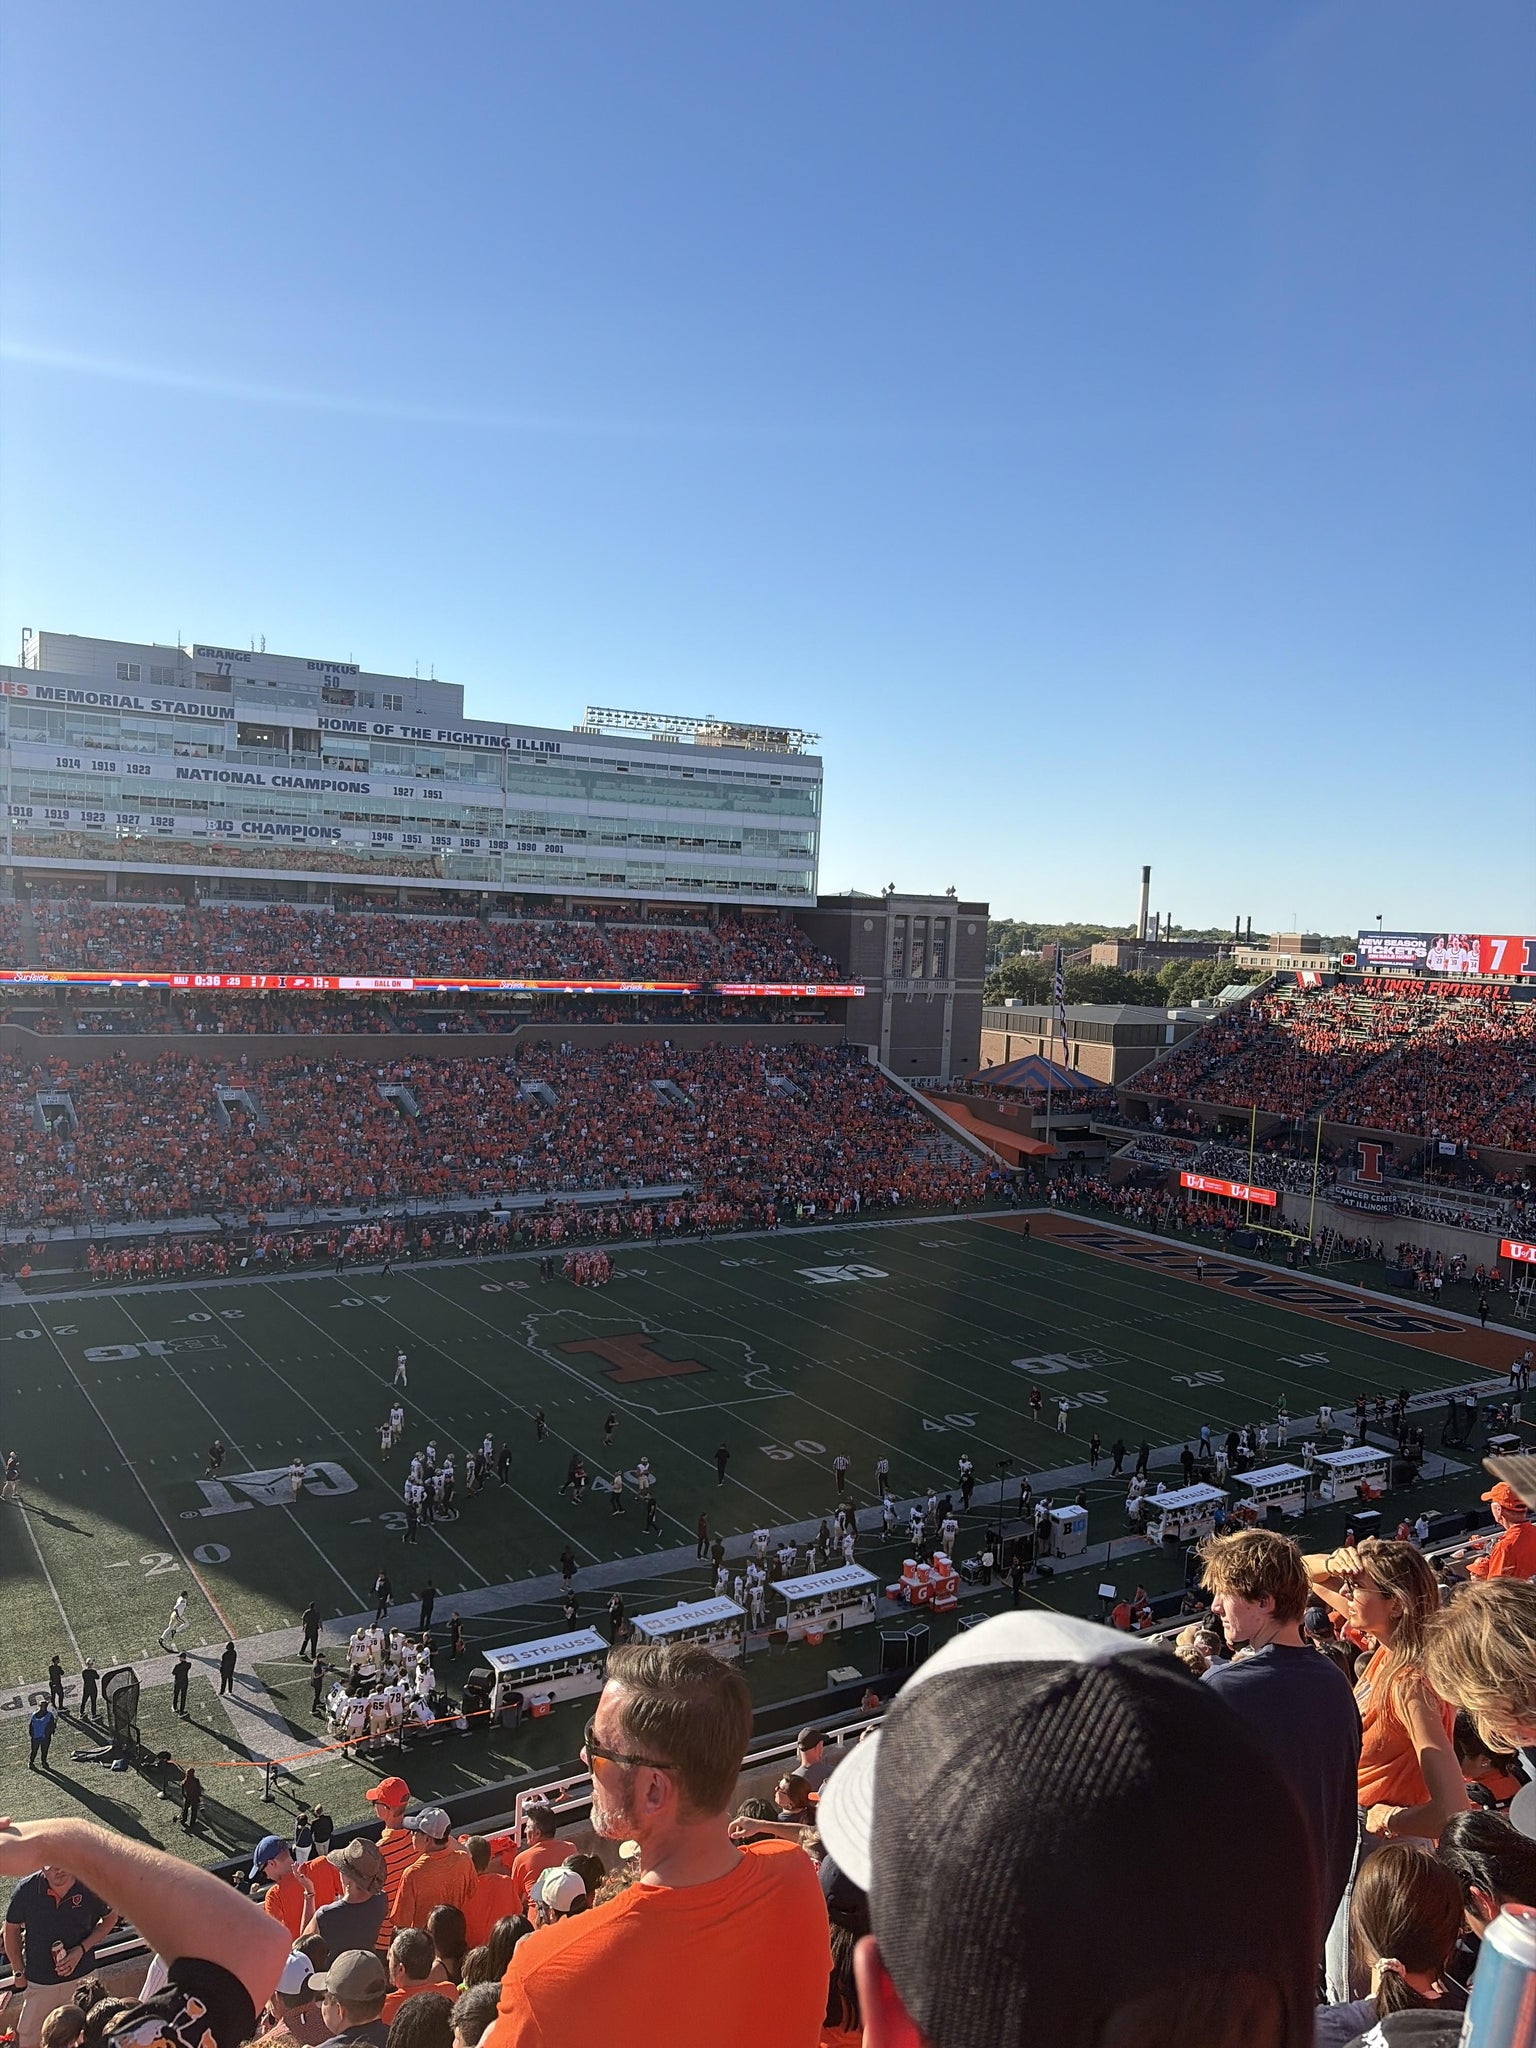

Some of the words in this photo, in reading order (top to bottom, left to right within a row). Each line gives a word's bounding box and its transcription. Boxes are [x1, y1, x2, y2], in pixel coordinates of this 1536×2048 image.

[197, 648, 252, 662] GRANGE
[216, 662, 232, 676] 77
[307, 661, 357, 675] BUTKUS
[324, 675, 340, 688] 50
[36, 686, 144, 710] MEMORIAL
[151, 699, 235, 719] STADIUM
[317, 717, 367, 733] HOME
[373, 723, 394, 736] OF
[400, 726, 432, 740] THE
[437, 730, 511, 748] FIGHTING
[516, 738, 561, 753] ILLINI
[56, 757, 81, 769] 1914
[91, 760, 116, 772] 1919
[126, 763, 151, 775] 1923
[176, 767, 266, 786] NATIONAL
[271, 775, 370, 794] CHAMPIONS
[393, 786, 415, 798] 1927
[423, 789, 443, 800] 1951
[7, 805, 33, 817] 1918
[44, 808, 70, 820] 1919
[80, 811, 106, 823] 1923
[116, 813, 141, 825] 1927
[150, 816, 175, 827] 1928
[241, 821, 342, 839] CHAMPIONS
[371, 831, 394, 842] 1946
[402, 833, 422, 844] 1951
[431, 836, 452, 846] 1953
[460, 838, 481, 848] 1963
[488, 840, 509, 850] 1983
[517, 842, 537, 852] 1990
[544, 844, 564, 854] 2001
[1359, 938, 1383, 946] NEW
[1384, 939, 1427, 948] SEASON
[1358, 944, 1427, 958] TICKETS
[1490, 939, 1508, 970] 7
[173, 976, 189, 985] HALF
[194, 975, 221, 986] 0:36
[260, 976, 267, 987] 7
[392, 980, 402, 988] ON
[1362, 977, 1425, 995] ILLINOIS
[1427, 979, 1512, 999] FOOTBALL
[1335, 1186, 1369, 1200] CANCER
[1370, 1194, 1397, 1203] CENTER
[1344, 1198, 1356, 1206] AT
[1356, 1201, 1388, 1212] ILLINOIS
[1050, 1231, 1467, 1334] ILLINOIS
[1170, 1487, 1216, 1504] STRAUSS
[758, 1534, 767, 1543] 57
[805, 1570, 866, 1591] STRAUSS
[918, 1586, 928, 1600] G
[664, 1602, 732, 1625] STRAUSS
[520, 1634, 596, 1660] STRAUSS
[390, 1693, 402, 1704] 78
[352, 1705, 364, 1714] 73
[372, 1702, 384, 1710] 65
